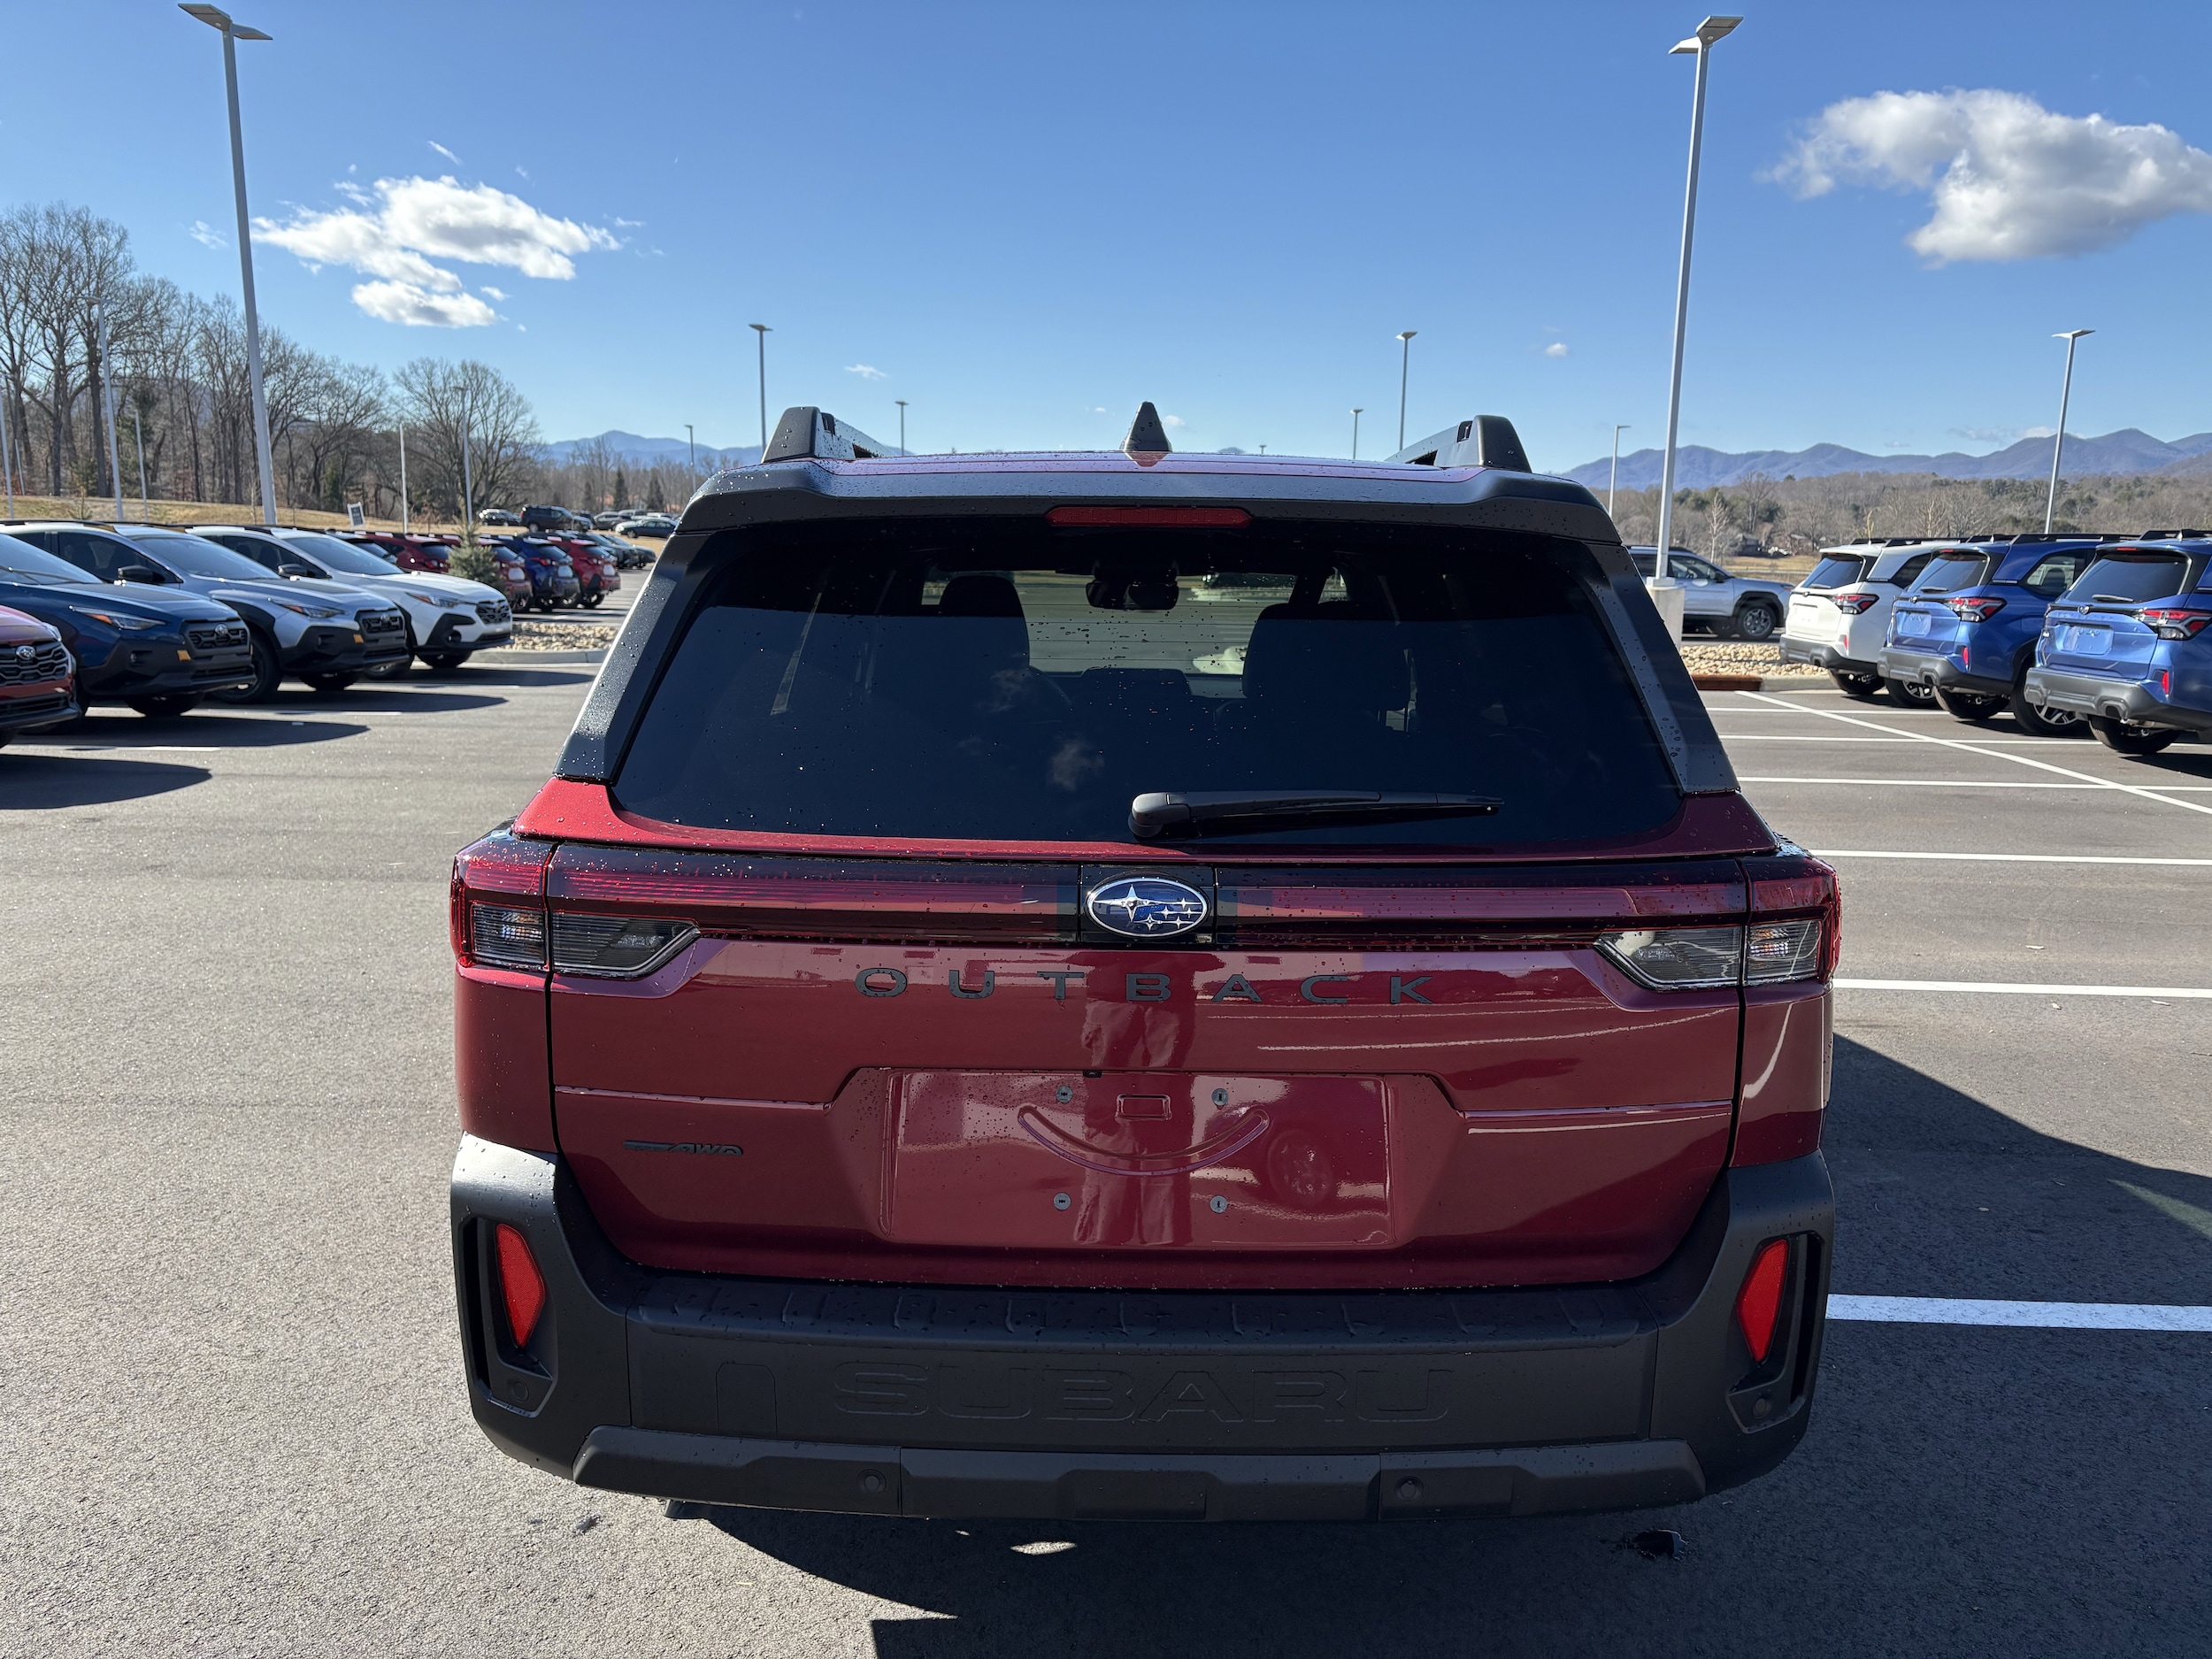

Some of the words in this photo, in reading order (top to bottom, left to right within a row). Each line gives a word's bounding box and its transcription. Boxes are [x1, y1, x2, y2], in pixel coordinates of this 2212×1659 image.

[855, 967, 1432, 1004] OUTBACK
[667, 1142, 744, 1156] AWD
[833, 1361, 1454, 1423] SUBARU
